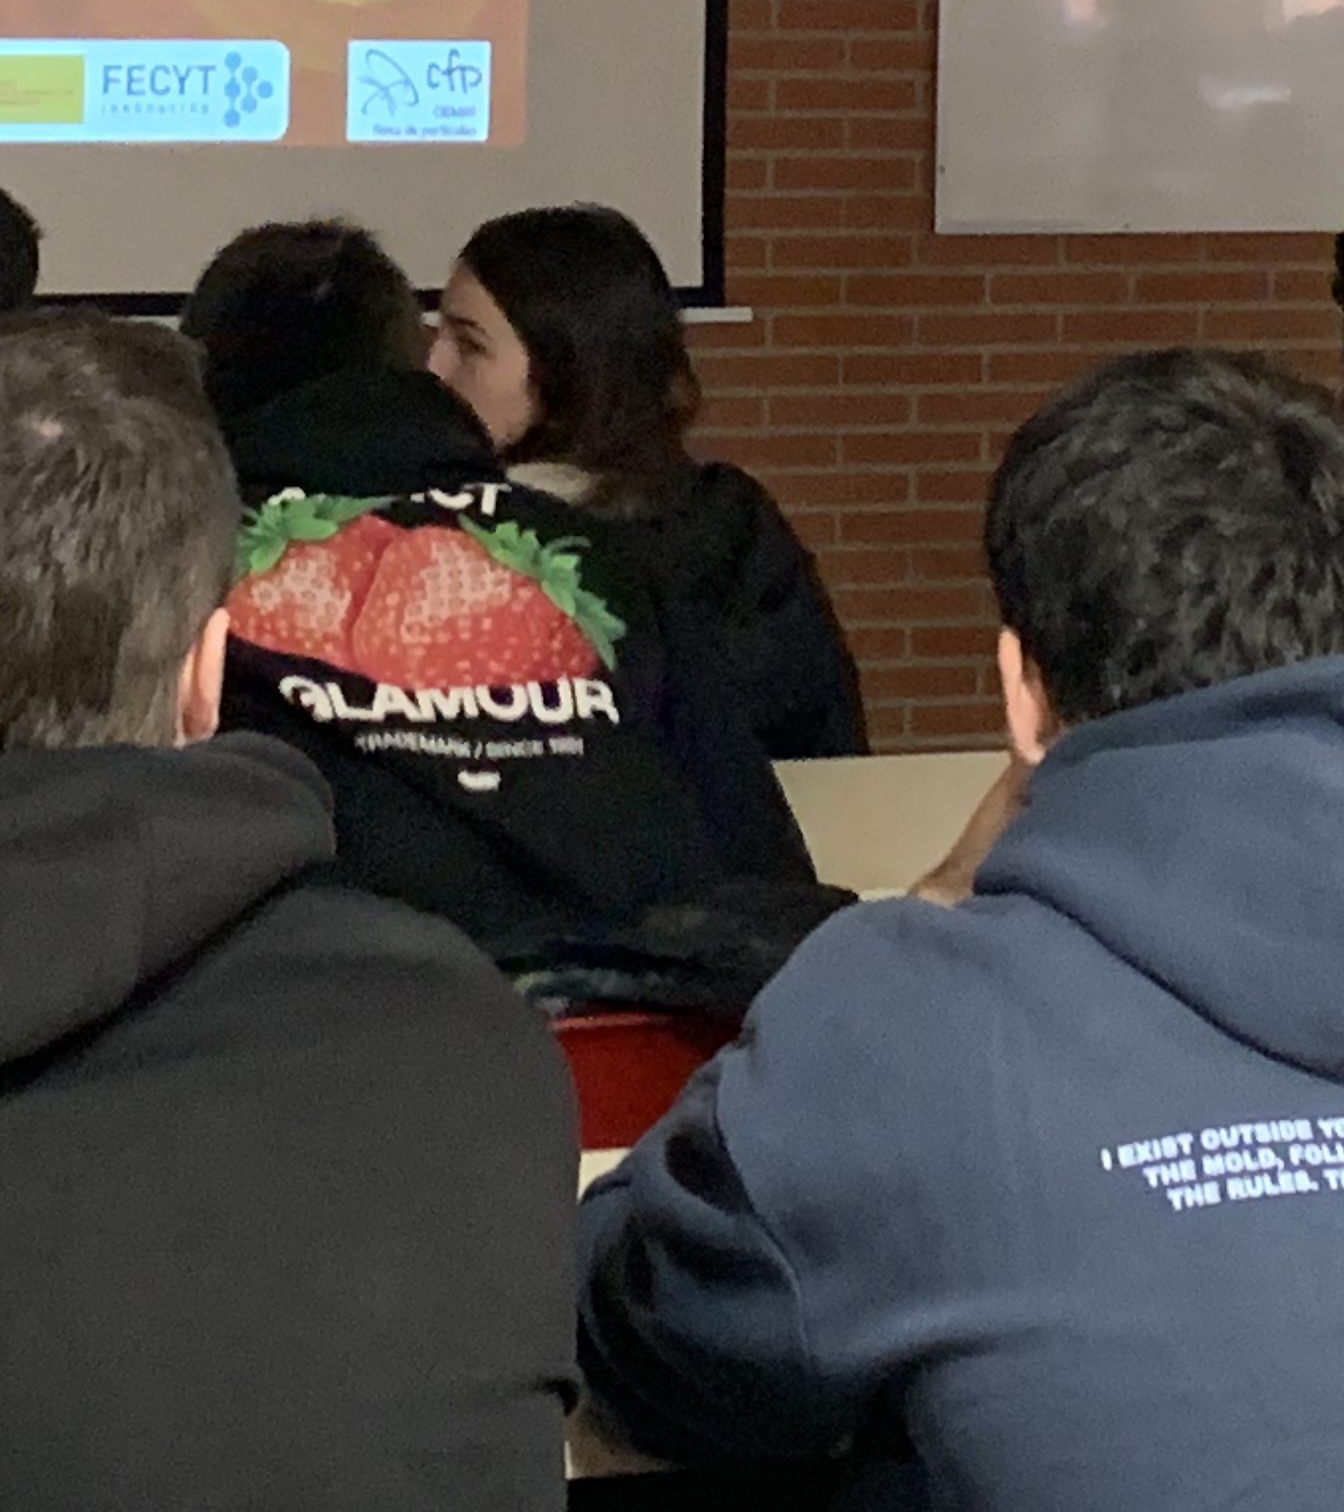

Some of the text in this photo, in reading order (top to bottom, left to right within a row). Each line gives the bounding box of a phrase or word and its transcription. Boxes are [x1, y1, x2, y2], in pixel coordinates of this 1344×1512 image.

[103, 64, 216, 96] FECYT
[278, 673, 620, 725] GLAMOUR
[1101, 1148, 1112, 1171] I
[1117, 1132, 1194, 1168] EXIST
[1200, 1118, 1315, 1151] OUTSIDE
[1142, 1159, 1198, 1188] THE
[1166, 1180, 1222, 1212] THE
